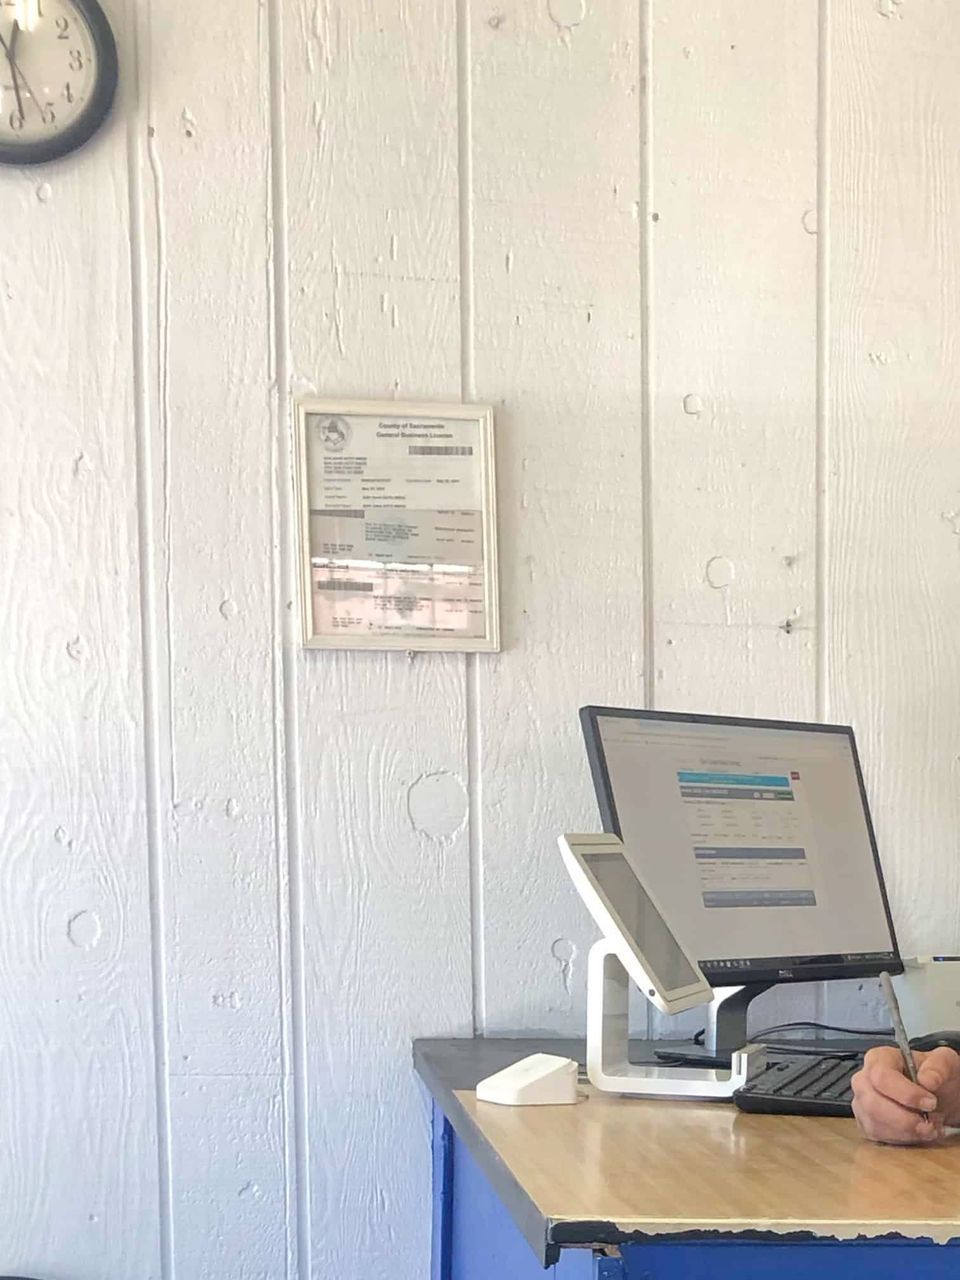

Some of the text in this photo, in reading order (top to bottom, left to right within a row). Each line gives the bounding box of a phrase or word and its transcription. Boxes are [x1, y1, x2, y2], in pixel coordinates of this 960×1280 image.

[56, 17, 69, 39] 2
[69, 50, 83, 72] 3
[62, 82, 73, 104] 4
[9, 110, 24, 131] 6
[42, 102, 56, 124] 5
